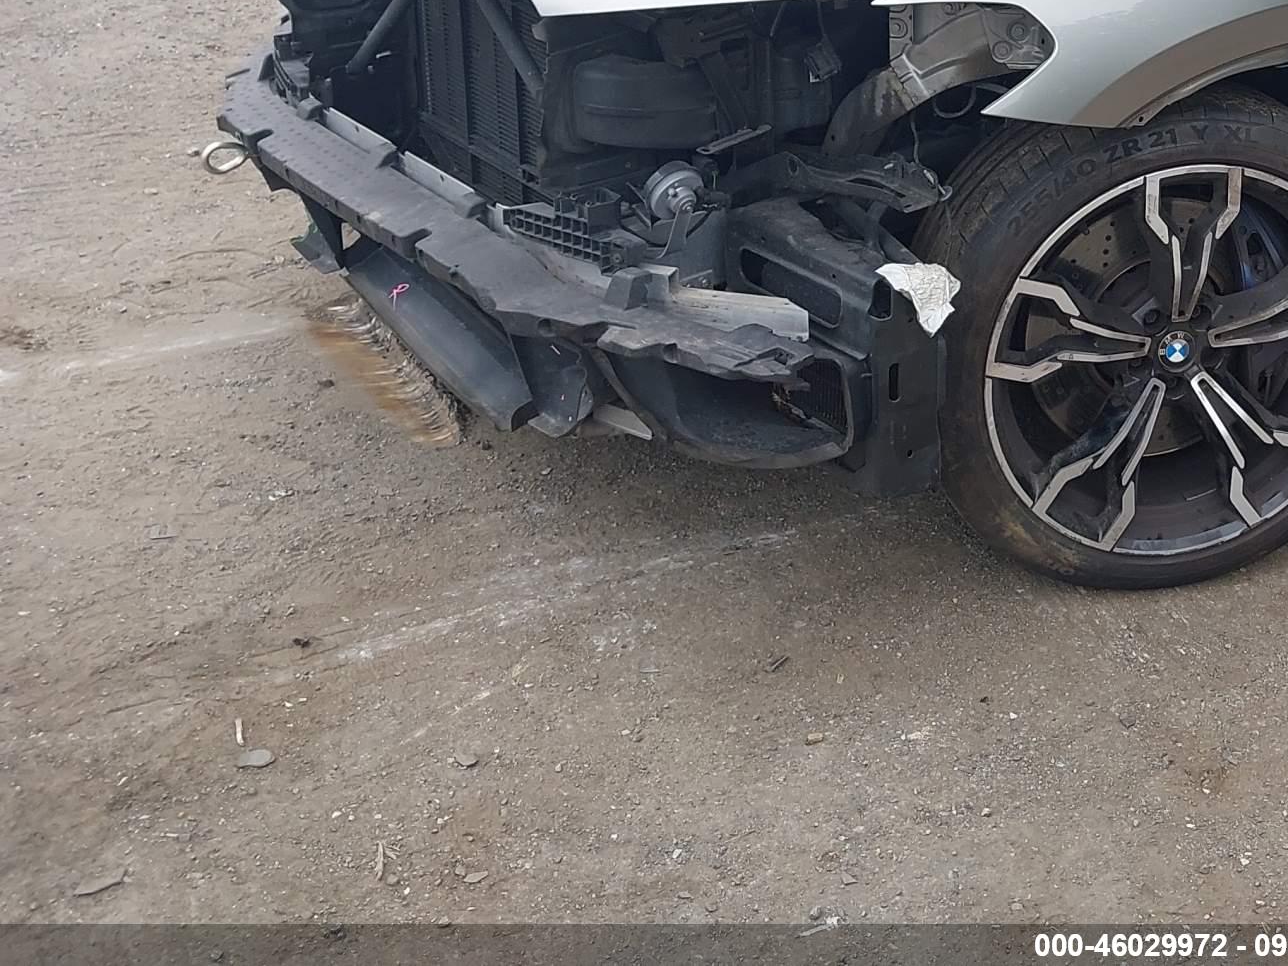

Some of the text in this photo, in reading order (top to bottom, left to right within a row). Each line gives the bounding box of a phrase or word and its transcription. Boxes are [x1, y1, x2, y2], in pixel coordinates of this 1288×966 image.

[1007, 158, 1097, 231] 255/40
[1102, 137, 1142, 164] ZR
[1149, 128, 1178, 148] 21
